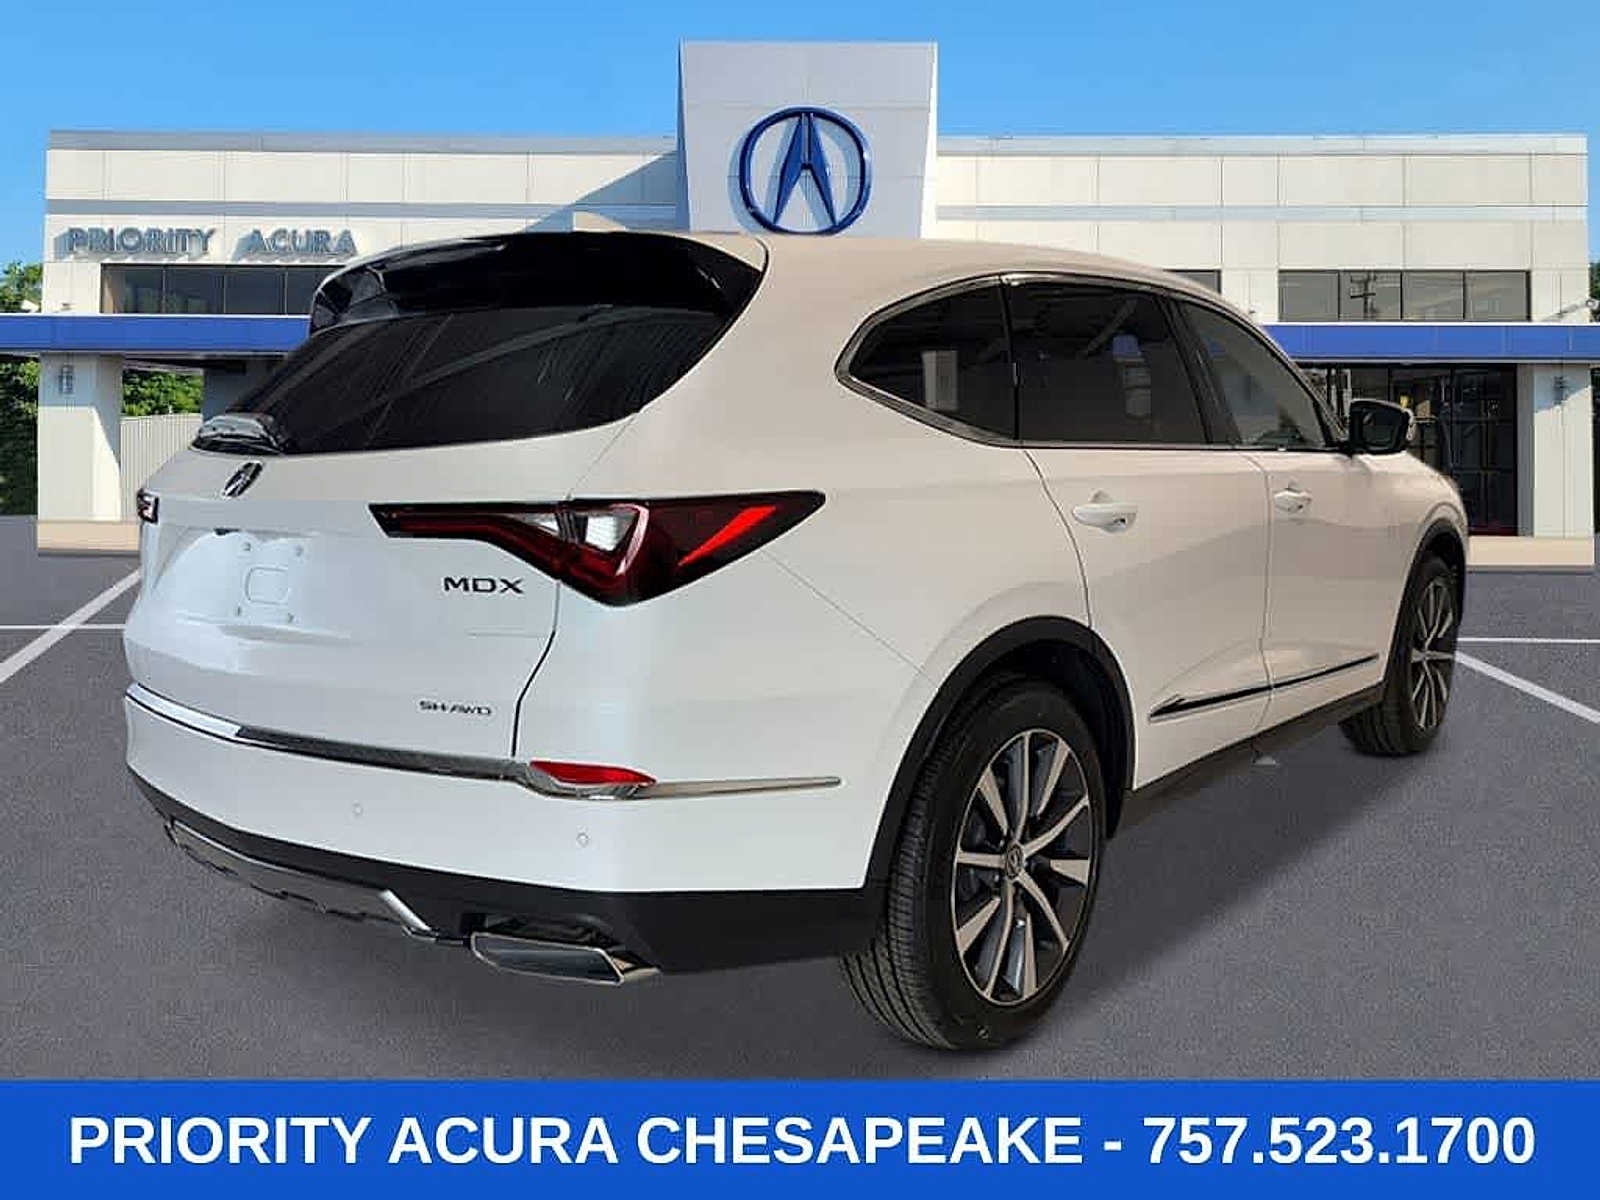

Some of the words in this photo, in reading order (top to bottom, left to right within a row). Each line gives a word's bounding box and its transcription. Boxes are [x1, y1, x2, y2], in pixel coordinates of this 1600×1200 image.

[66, 227, 216, 252] PRIORITY
[248, 228, 358, 253] ACURA
[443, 576, 525, 594] MDX
